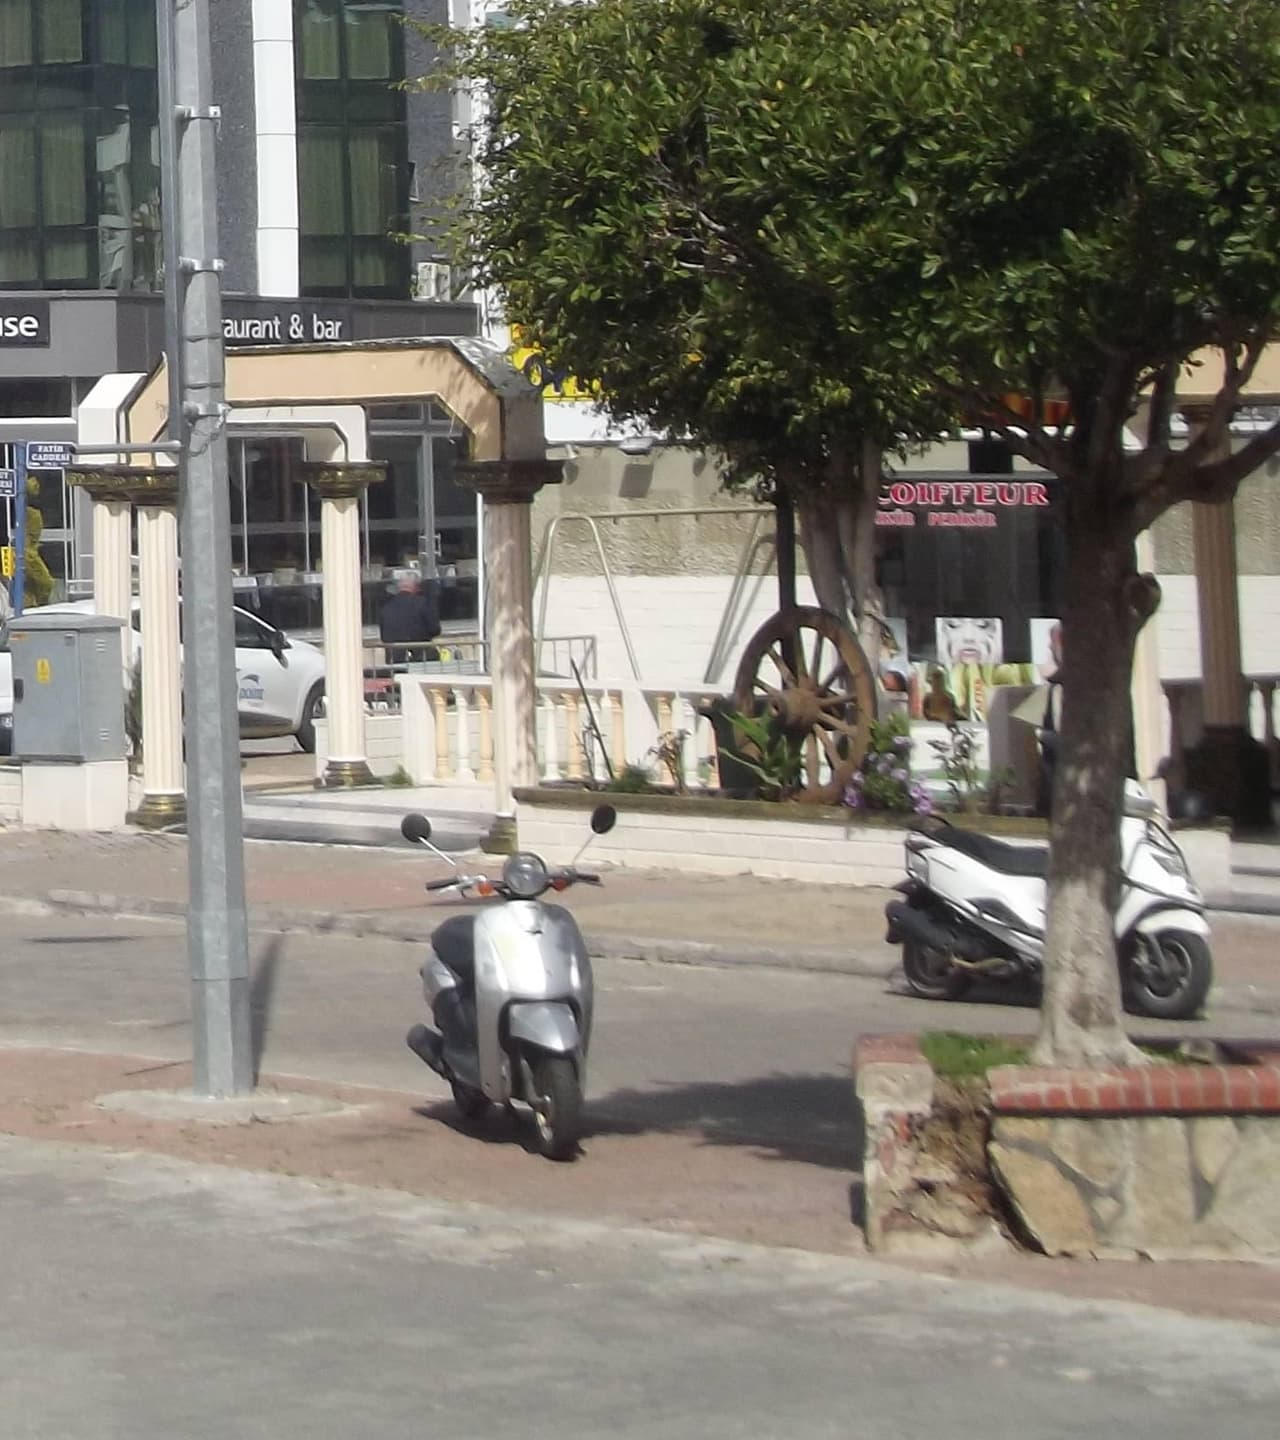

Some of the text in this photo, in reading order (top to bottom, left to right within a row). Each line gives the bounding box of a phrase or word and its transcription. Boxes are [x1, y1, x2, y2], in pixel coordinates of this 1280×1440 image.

[221, 313, 343, 340] aurant & bar
